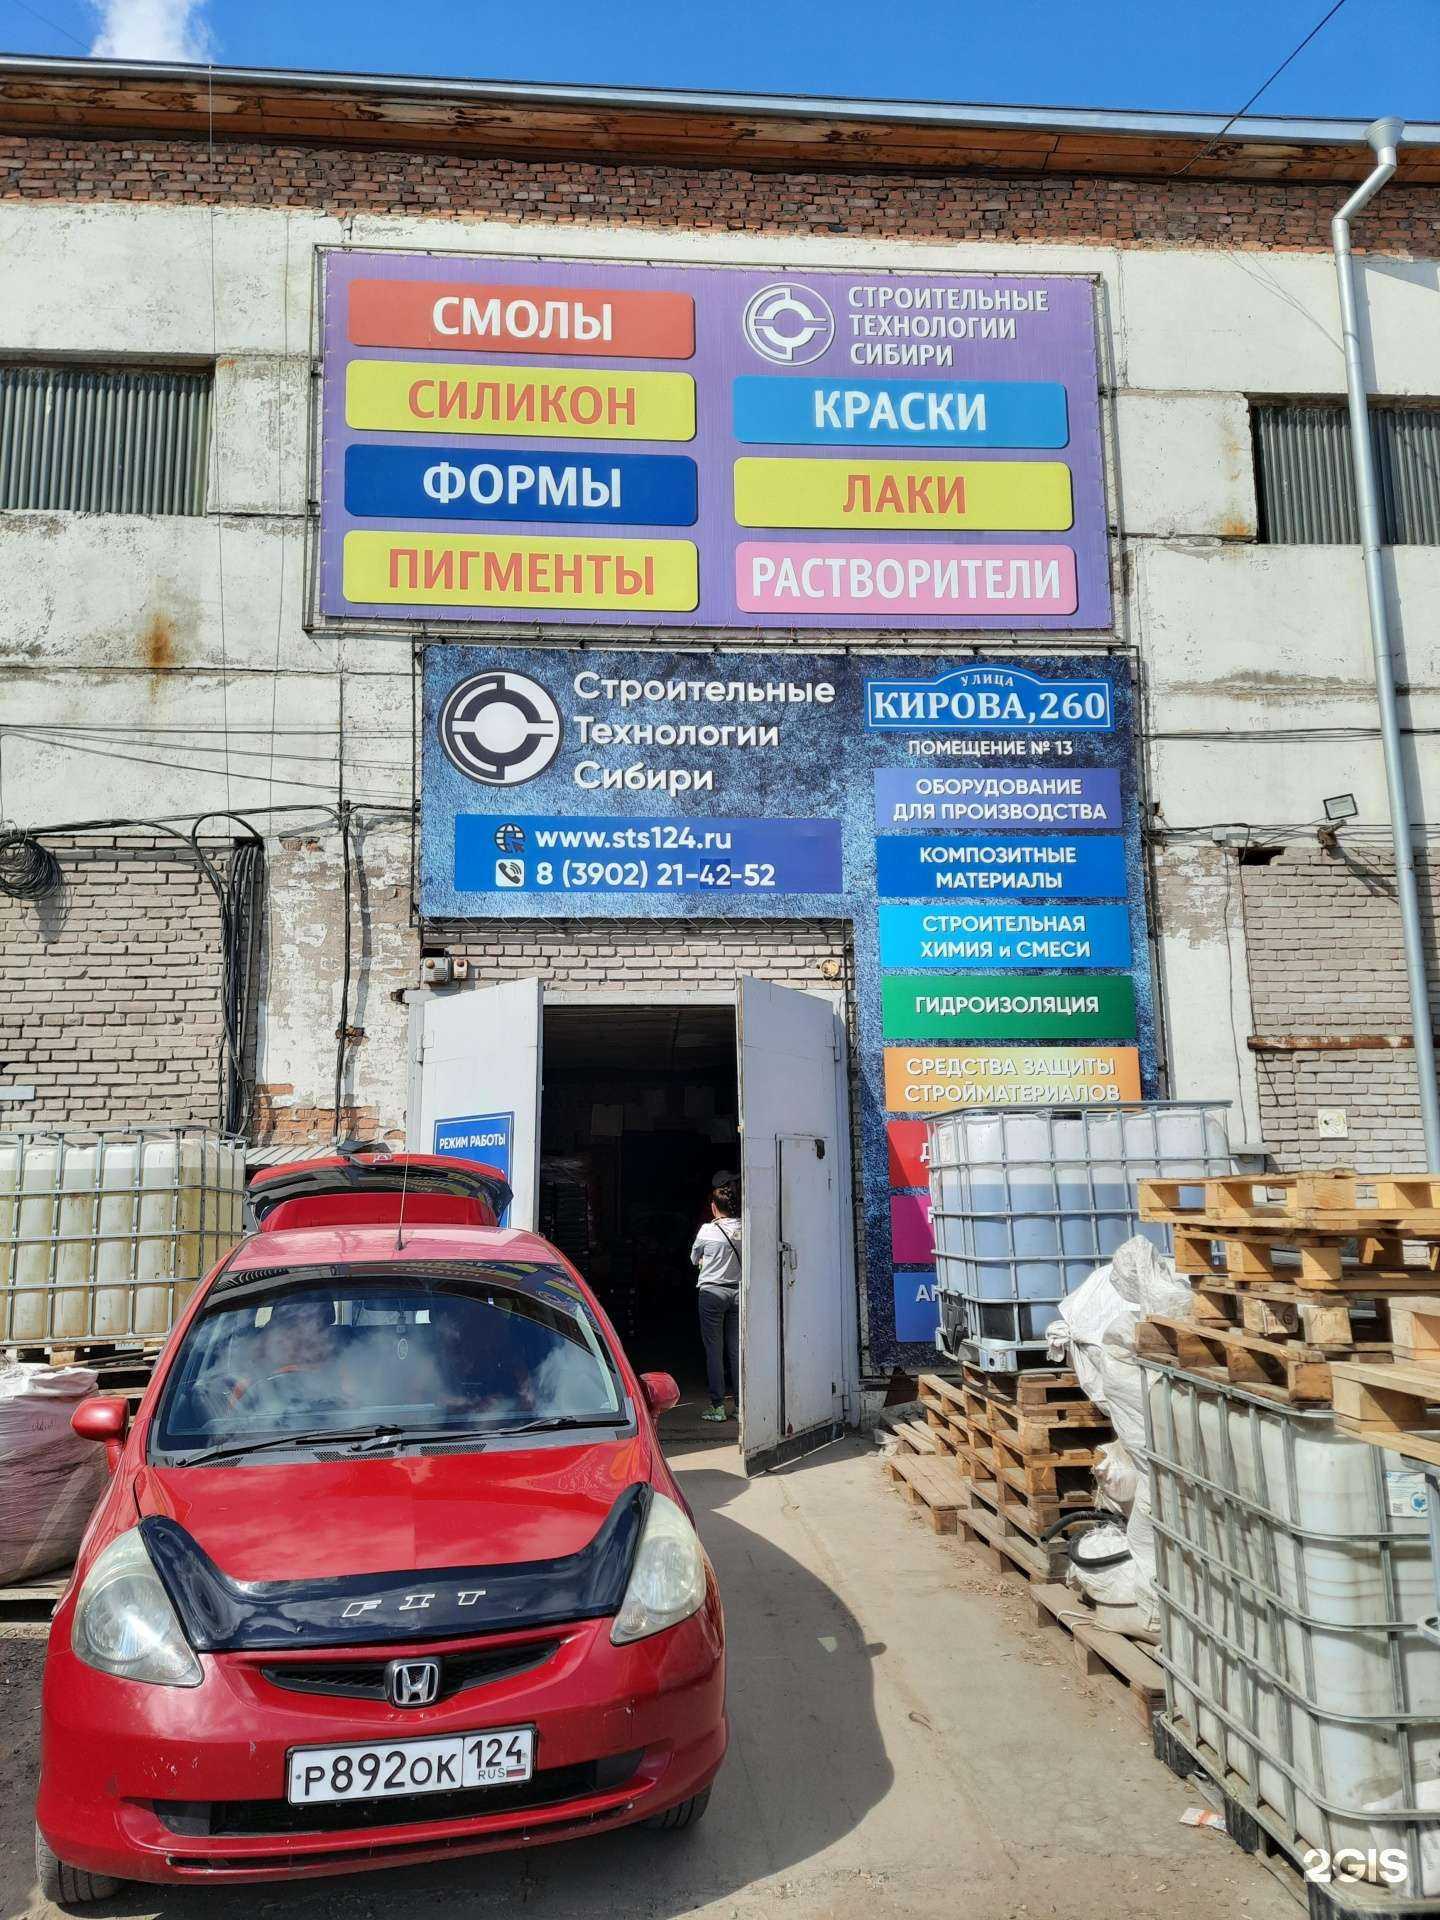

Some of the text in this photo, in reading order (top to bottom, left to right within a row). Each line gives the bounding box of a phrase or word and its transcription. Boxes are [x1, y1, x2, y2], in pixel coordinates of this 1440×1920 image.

[848, 285, 1049, 312] СТРОИТЕЛЬНЫЕ
[432, 296, 612, 341] СМОЛЫ
[848, 313, 1017, 340] ТЕХНОЛОГИИ
[849, 342, 955, 367] СИБИРИ
[407, 379, 636, 426] СИЛИКОН
[813, 389, 987, 432] КРАСКИ
[422, 461, 621, 508] ФОРМЫ
[842, 474, 966, 515] ЛАКИ
[388, 547, 654, 596] ПИГМЕНТЫ
[752, 556, 1062, 600] РАСТВОРИТЕЛИ
[573, 671, 836, 707] Строительные
[960, 672, 1015, 687] УЛИЦА
[573, 716, 780, 747] Технологии
[908, 740, 1073, 758] ПОМЕЩЕНИЕ № 13
[573, 760, 715, 797] Сибири
[915, 778, 1082, 797] ОБОРУДОВАНИЕ
[892, 803, 1108, 822] ДЛЯ ПРОИЗВОДСТВА
[535, 826, 732, 850] www.sts124.ru
[919, 846, 1077, 864] КОМПОЗИТНЫЕ
[535, 860, 776, 889] 8 (3902) 21-42-52
[935, 872, 1063, 889] МАТЕРИАЛЫ
[922, 915, 1086, 932] СТРОИТЕЛЬНАЯ
[920, 941, 1091, 958] ХИМИЯ и СМЕСИ
[914, 996, 1099, 1016] ГИДРОИЗОЛЯЦИЯ
[906, 1057, 1115, 1078] СРЕДСТВА ЗАЩИТЫ
[904, 1083, 1121, 1103] СТРОЙМАТЕРИАЛОВ
[439, 1133, 506, 1150] РЕЖИМ РАБОТЫ
[341, 1590, 486, 1618] FIT
[468, 1736, 524, 1769] 124
[478, 1767, 506, 1781] RUS
